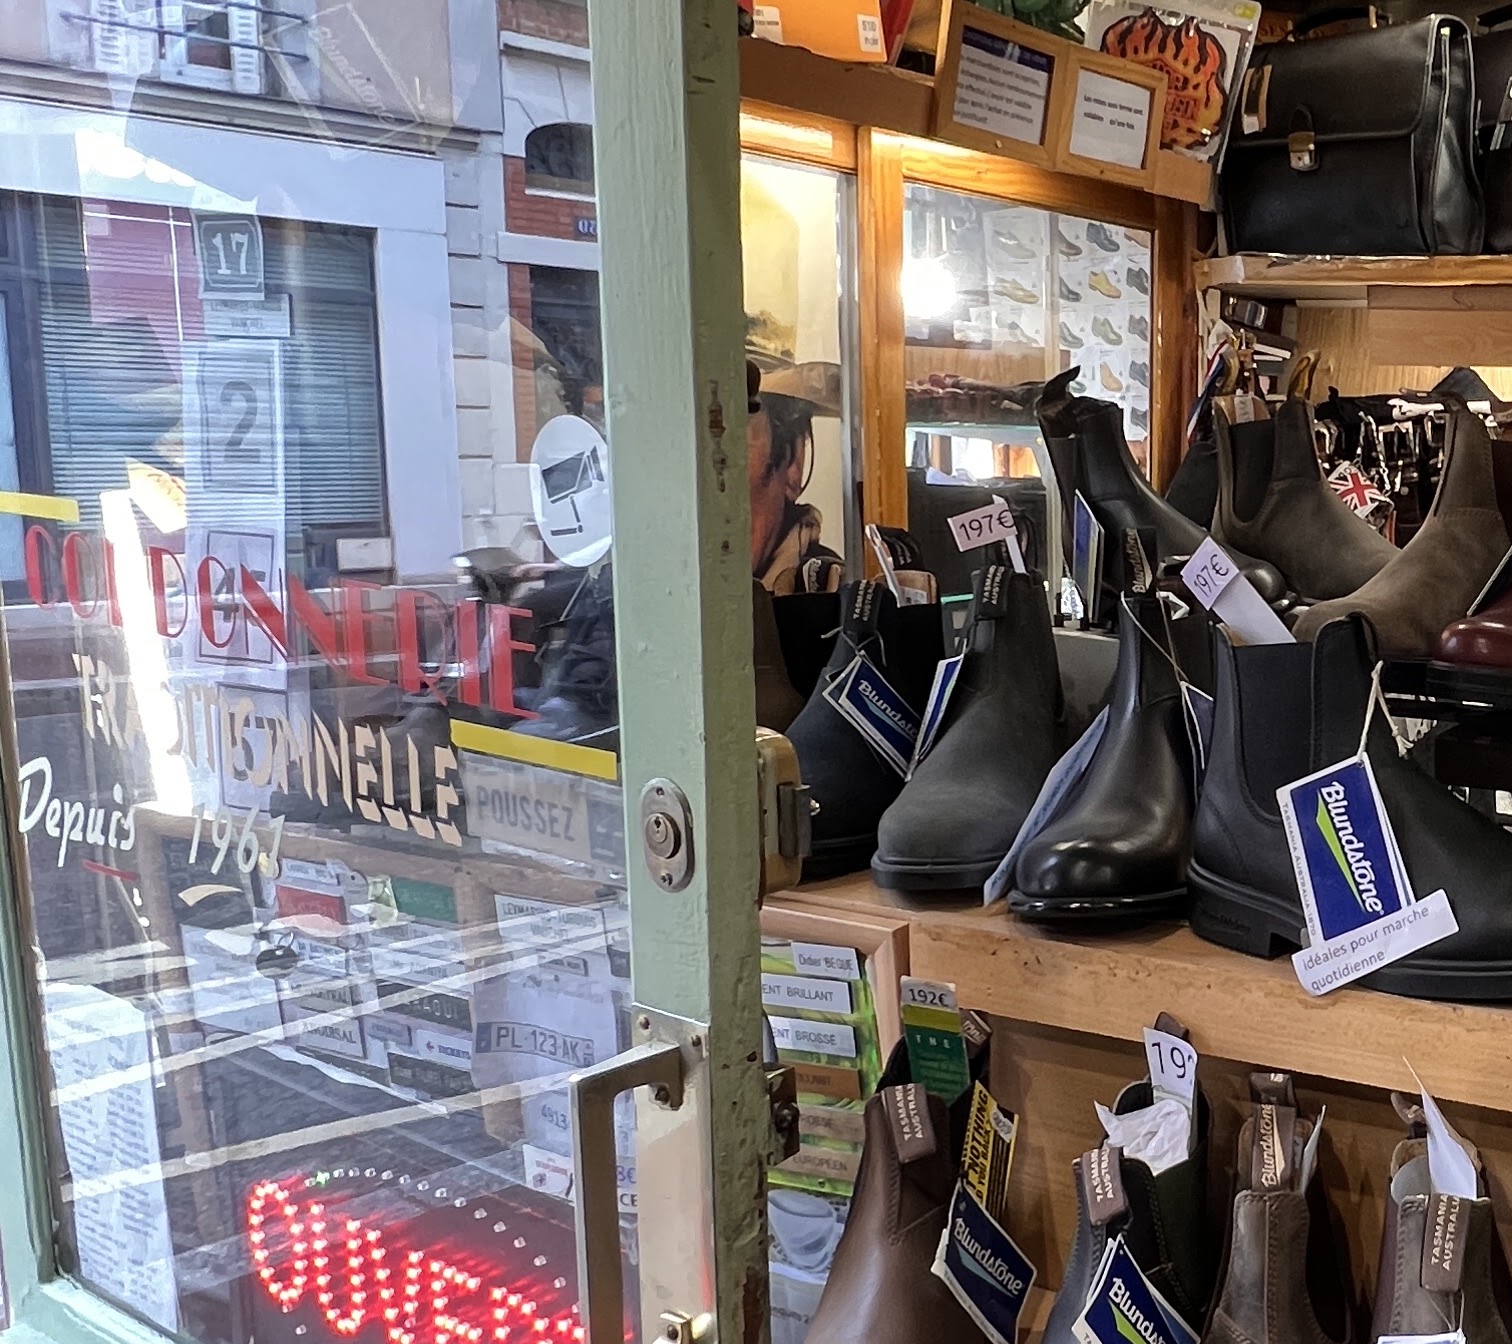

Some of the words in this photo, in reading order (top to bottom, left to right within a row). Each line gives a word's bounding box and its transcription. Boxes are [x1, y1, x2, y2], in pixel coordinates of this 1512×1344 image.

[210, 231, 250, 276] 17
[219, 380, 260, 464] 2
[958, 508, 1016, 542] 197€
[1192, 552, 1230, 599] 197€
[18, 755, 137, 868] Depuis
[476, 785, 576, 843] POUSSEZ
[1320, 780, 1384, 915] Blundstone
[1349, 927, 1380, 953] pour
[1382, 904, 1431, 937] marche
[762, 982, 782, 997] ENT
[786, 986, 835, 1003] BRILLANT
[1310, 949, 1386, 994] quotidienne
[907, 987, 949, 1007] 192€
[1151, 1041, 1196, 1079] 19
[1260, 1104, 1277, 1188] Blundstone
[954, 1217, 1023, 1295] Blundstone
